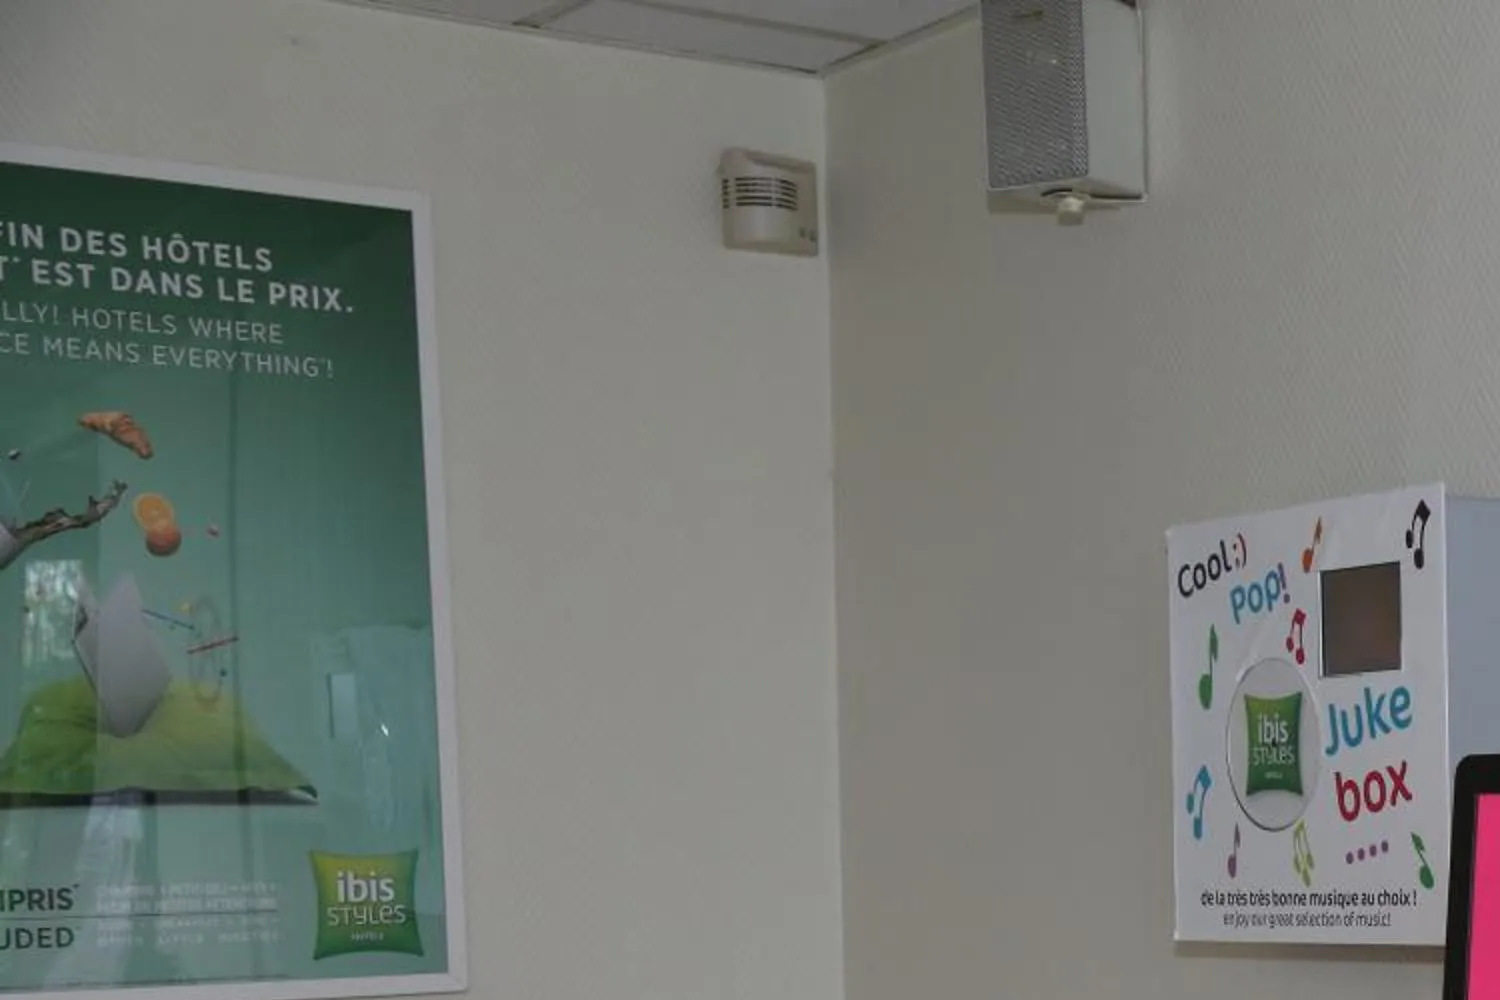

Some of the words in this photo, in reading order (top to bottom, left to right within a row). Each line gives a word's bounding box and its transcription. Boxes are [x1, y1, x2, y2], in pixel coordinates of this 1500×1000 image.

[0, 221, 44, 249] IN
[60, 226, 128, 257] DES
[142, 233, 273, 272] HÔTELS
[31, 258, 96, 289] EST
[111, 266, 204, 299] DANS
[217, 276, 255, 303] LE
[268, 281, 353, 313] PRIX.
[72, 307, 177, 335] HOTELS
[189, 316, 283, 344] WHERE
[43, 336, 140, 363] MEANS
[1258, 712, 1289, 744] ibis
[1325, 686, 1412, 756] Juke
[1334, 759, 1413, 822] box
[337, 871, 396, 902] ibis
[1201, 889, 1214, 906] de
[1215, 889, 1225, 906] la
[1227, 889, 1248, 906] très
[1249, 889, 1271, 906] très
[1272, 888, 1306, 906] bonne
[1310, 889, 1358, 909] musique
[1361, 892, 1375, 906] au
[1377, 888, 1410, 906] choix
[1223, 912, 1249, 928] enjoy
[1269, 913, 1293, 928] great
[1296, 911, 1342, 926] selection
[1344, 912, 1355, 926] of
[1356, 912, 1391, 927] music!
